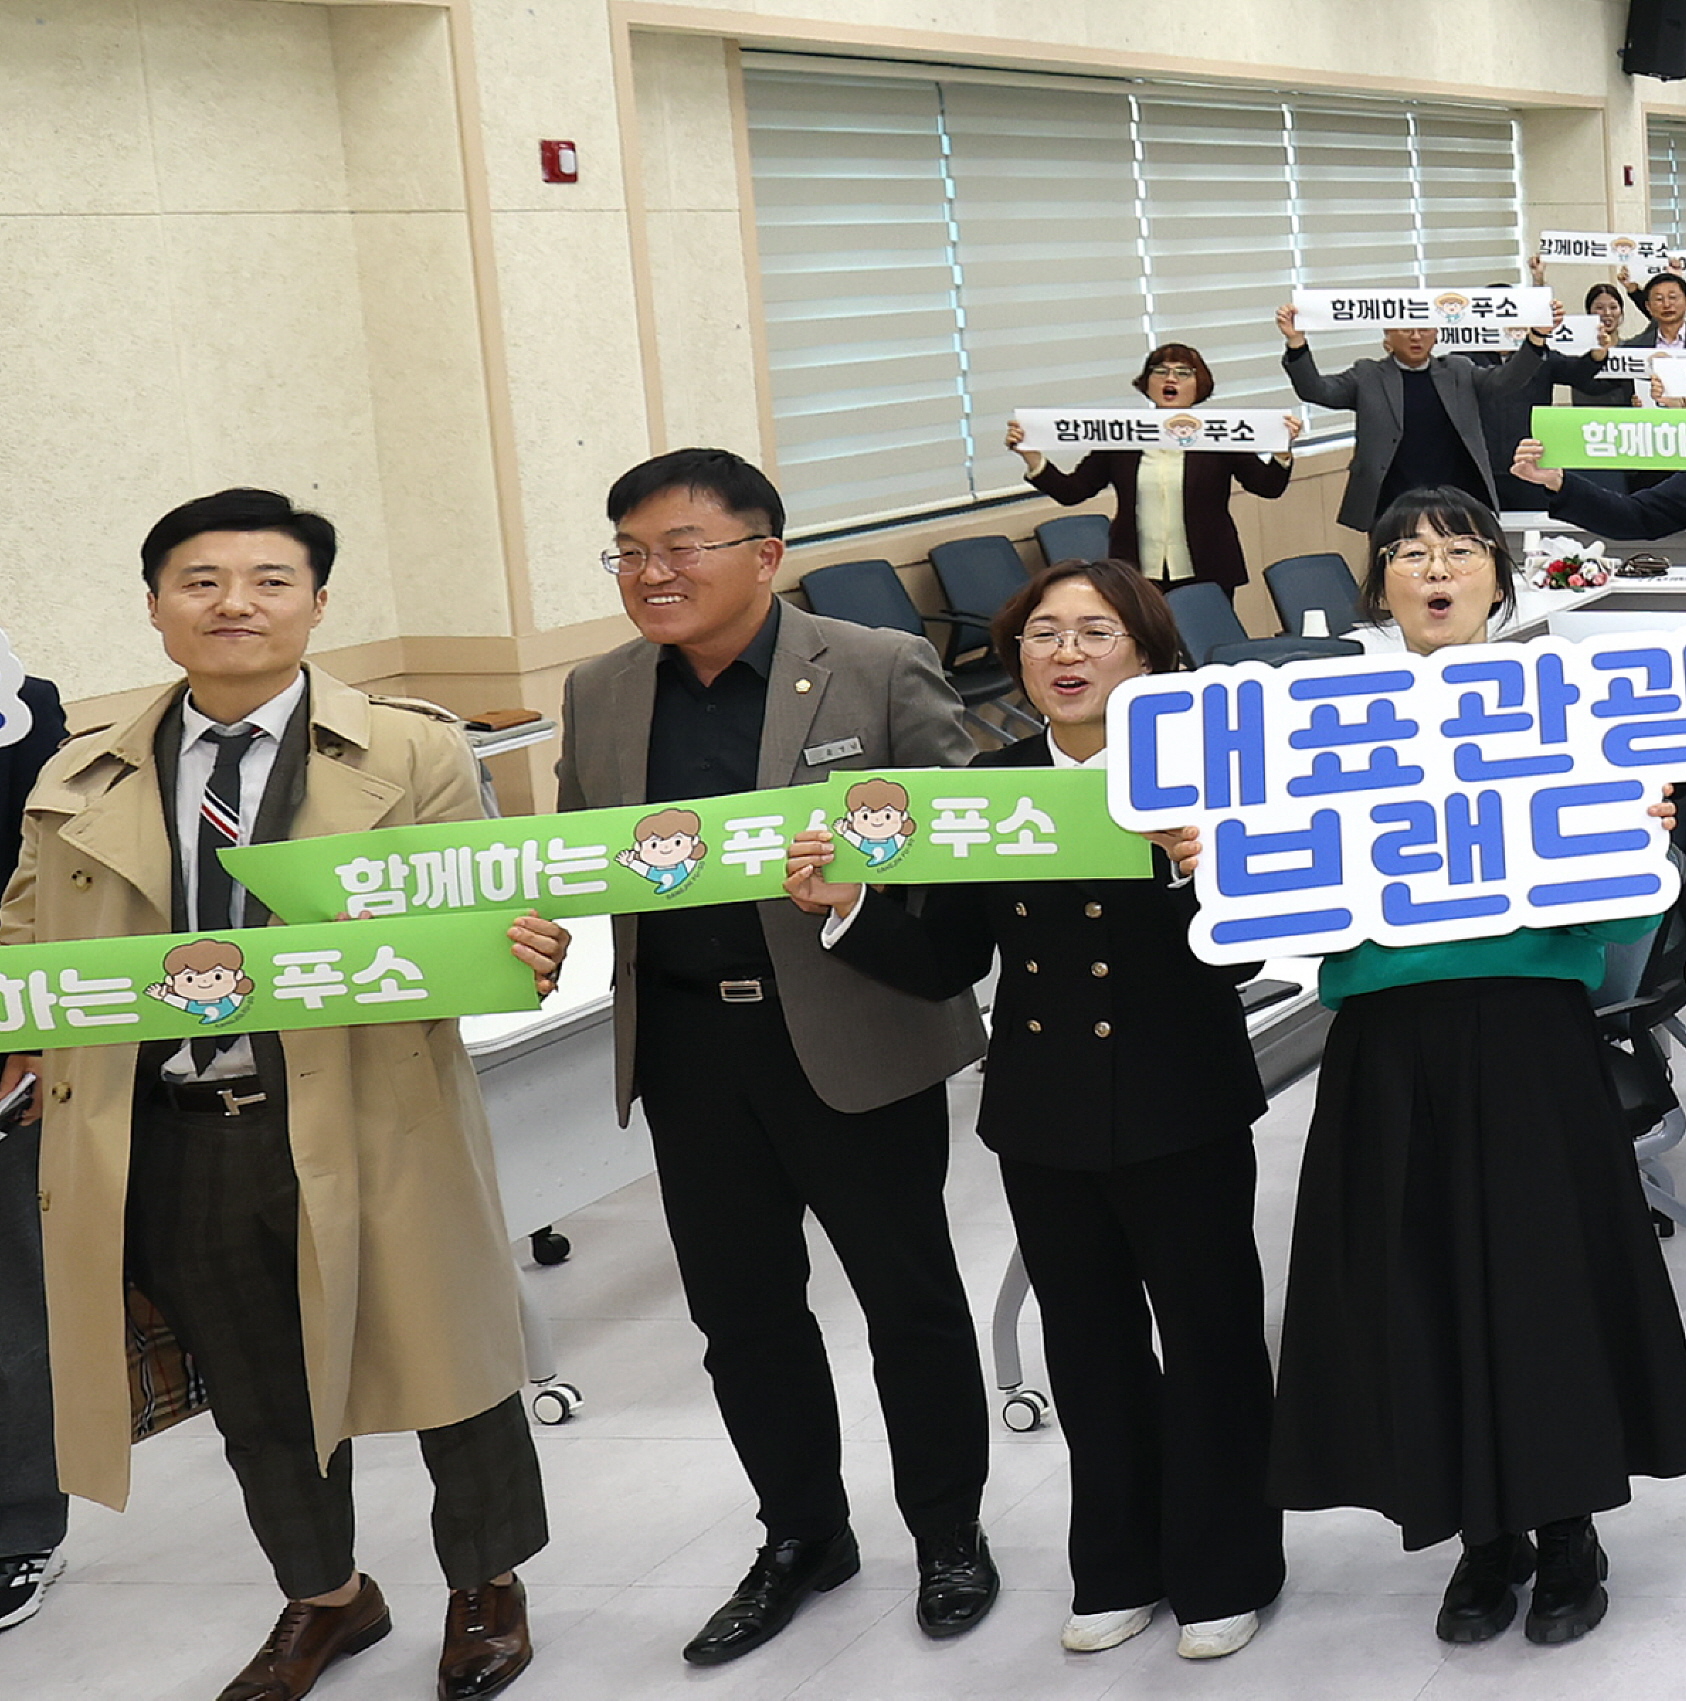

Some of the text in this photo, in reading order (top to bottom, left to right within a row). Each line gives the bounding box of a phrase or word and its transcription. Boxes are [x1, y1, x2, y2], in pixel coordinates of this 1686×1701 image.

[1638, 241, 1669, 259] 푸소
[1332, 297, 1518, 321] 함께하는 푸소
[1435, 326, 1500, 345] 께하는
[1055, 419, 1255, 442] 함께하는 푸소
[722, 807, 828, 875] 푸
[928, 796, 1058, 858] 푸소
[334, 838, 609, 918] 함께하는
[1210, 780, 1662, 946] 브랜드
[272, 944, 429, 1009] 푸소
